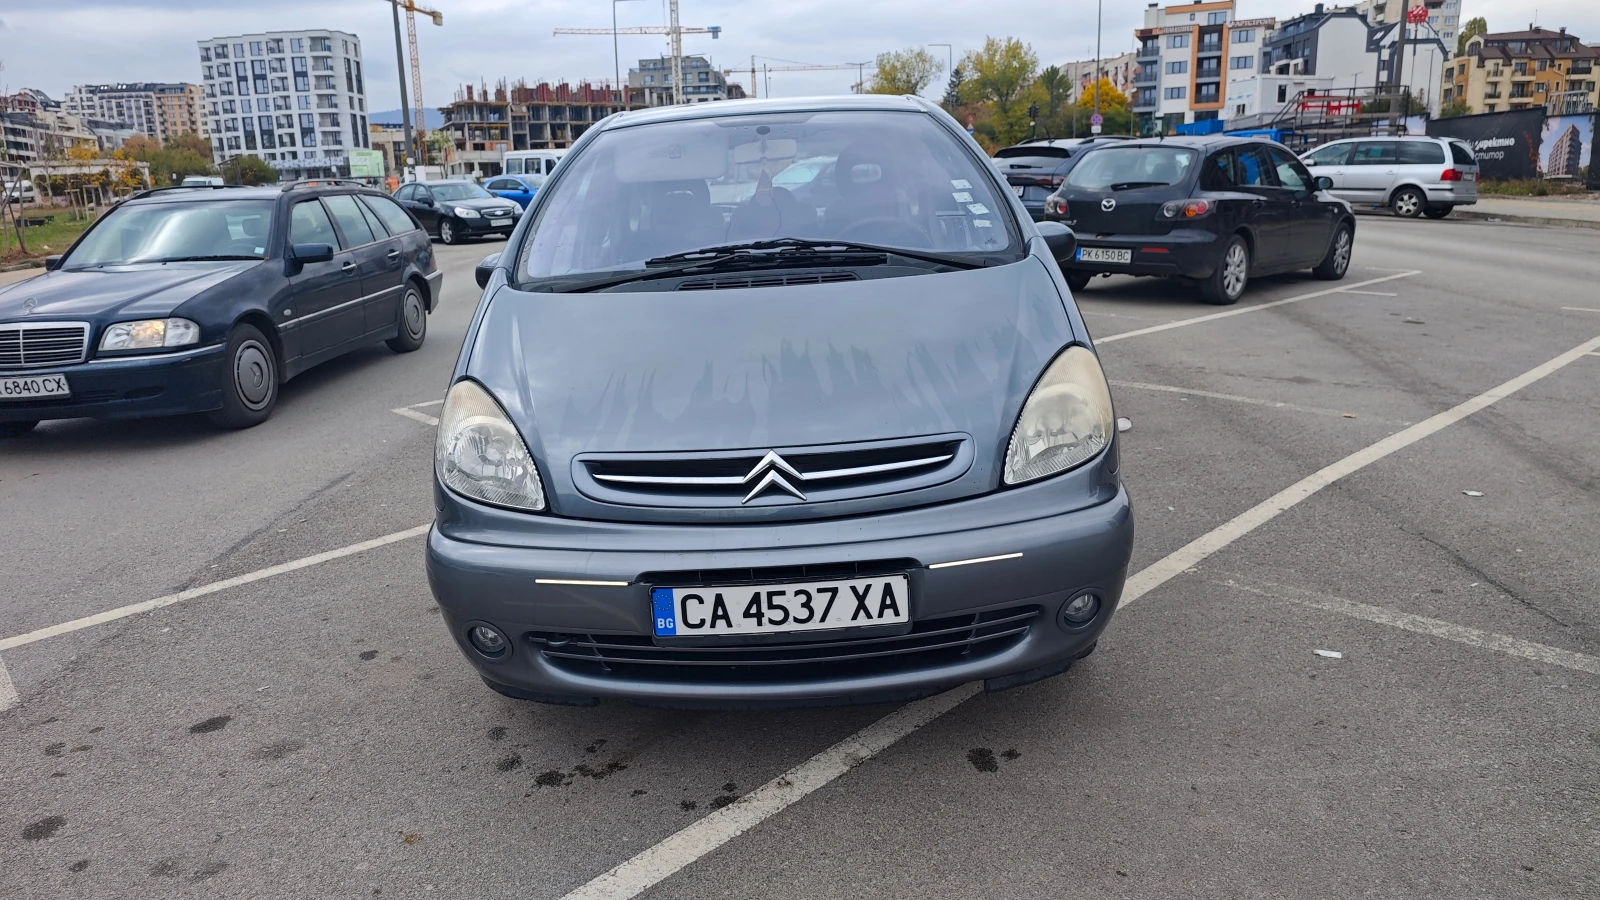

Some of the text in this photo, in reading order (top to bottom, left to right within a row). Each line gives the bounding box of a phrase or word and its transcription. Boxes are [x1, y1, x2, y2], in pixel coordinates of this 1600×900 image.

[1474, 151, 1504, 161] ститор
[1082, 249, 1129, 262] PK 6150 BC
[4, 379, 40, 395] 6840
[42, 377, 66, 393] CX
[680, 582, 901, 630] CA 4537 XA
[657, 617, 674, 630] BG
